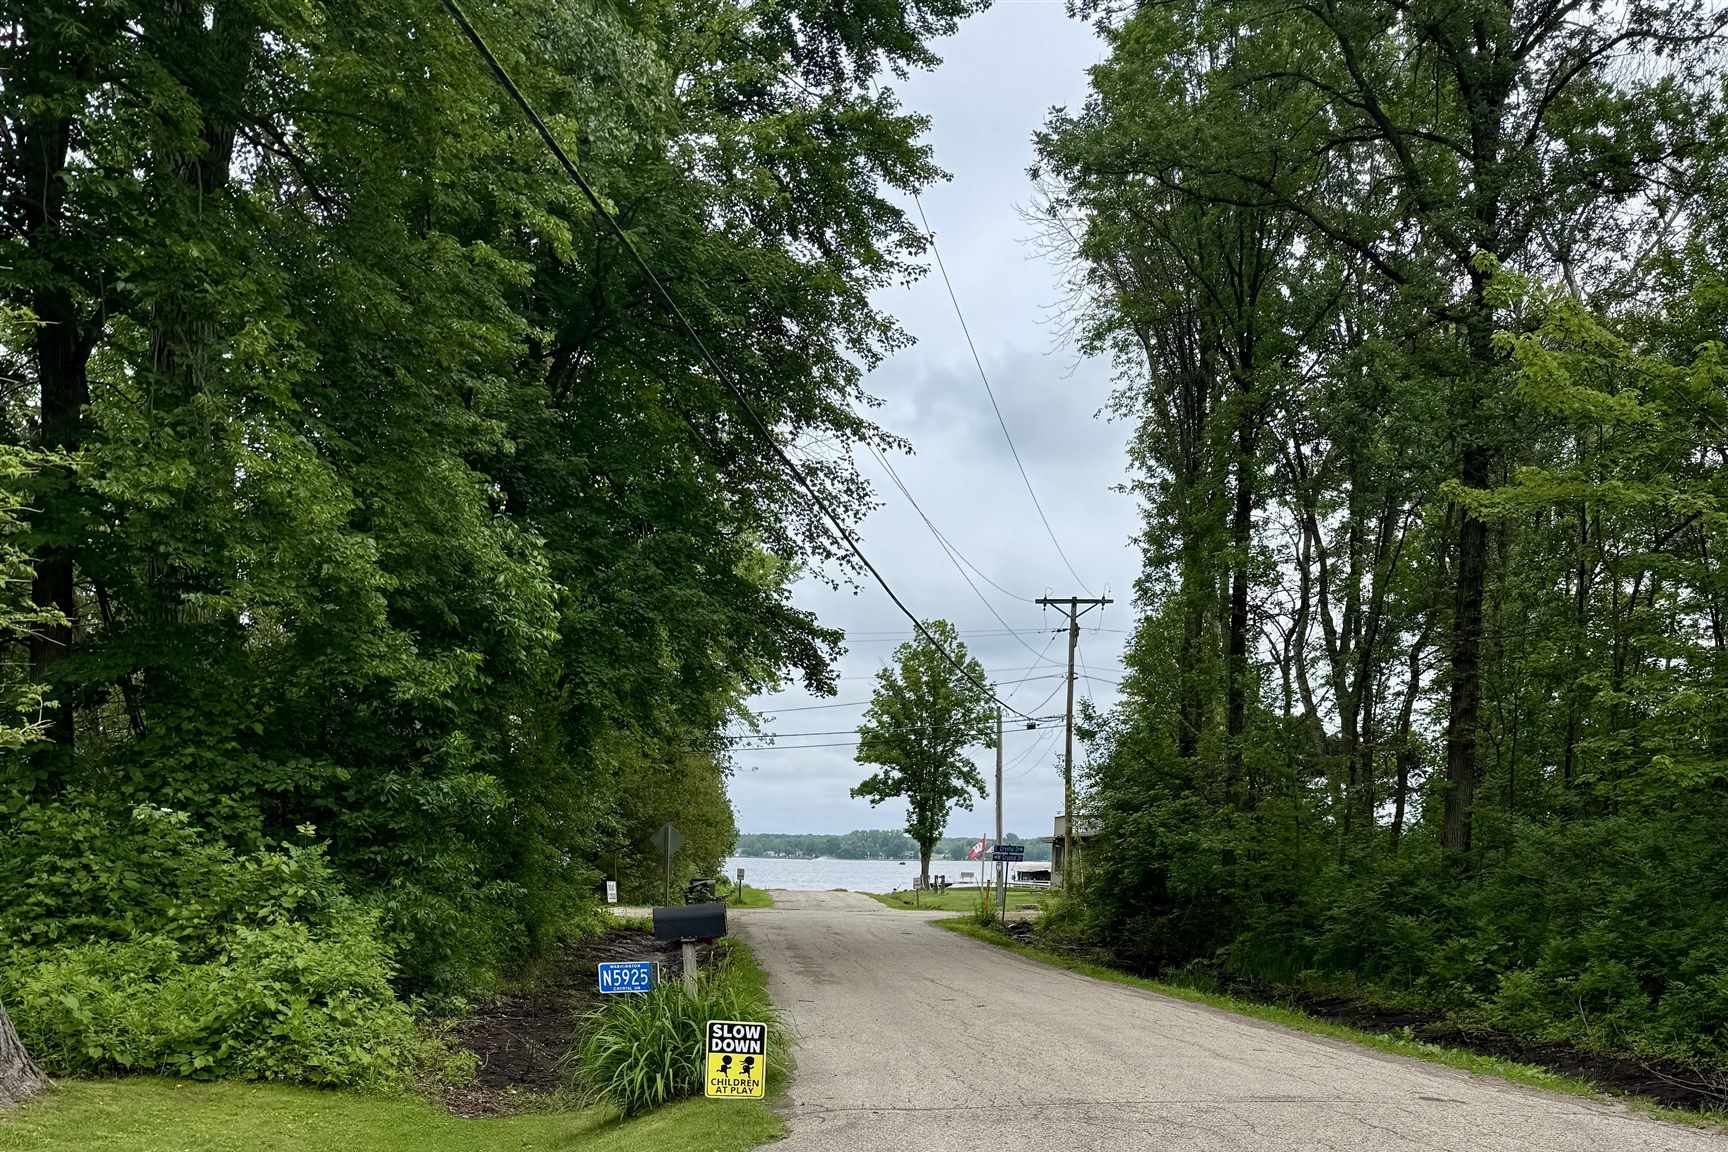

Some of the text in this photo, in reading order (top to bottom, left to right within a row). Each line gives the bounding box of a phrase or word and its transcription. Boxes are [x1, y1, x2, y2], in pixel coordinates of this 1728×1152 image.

[602, 969, 648, 986] N5925
[712, 1024, 761, 1039] SLOW
[711, 1038, 761, 1053] DOWN
[711, 1078, 759, 1087] CHILDREN
[716, 1086, 754, 1095] AT PLAY
